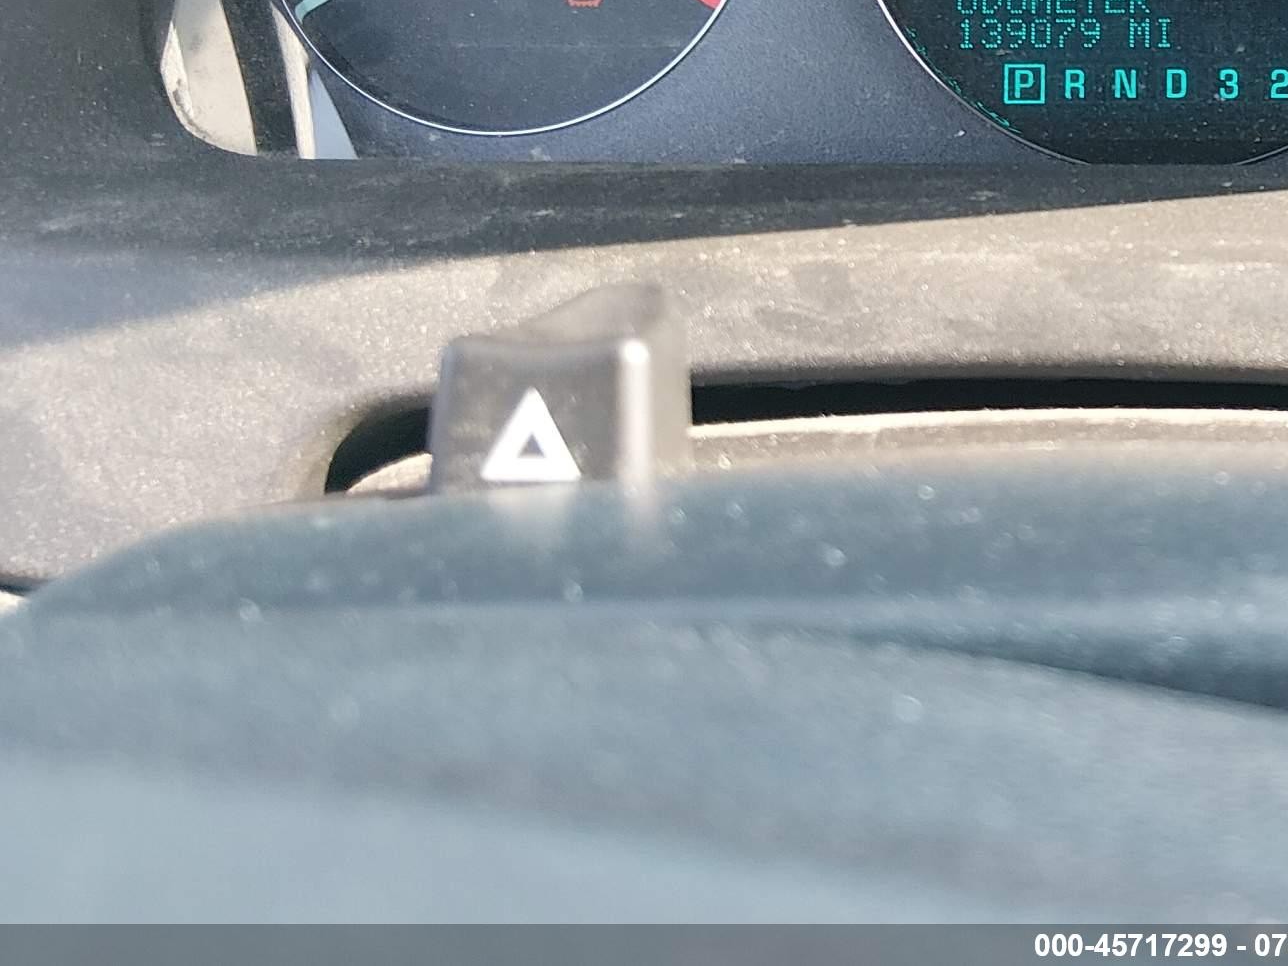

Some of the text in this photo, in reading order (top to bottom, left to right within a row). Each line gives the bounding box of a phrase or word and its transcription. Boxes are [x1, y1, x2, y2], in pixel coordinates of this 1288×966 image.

[960, 18, 1172, 48] 139079 MI
[1014, 69, 1034, 99] P
[1064, 69, 1086, 99] R
[1114, 69, 1137, 99] N
[1166, 69, 1188, 99] D
[1218, 69, 1240, 99] 3
